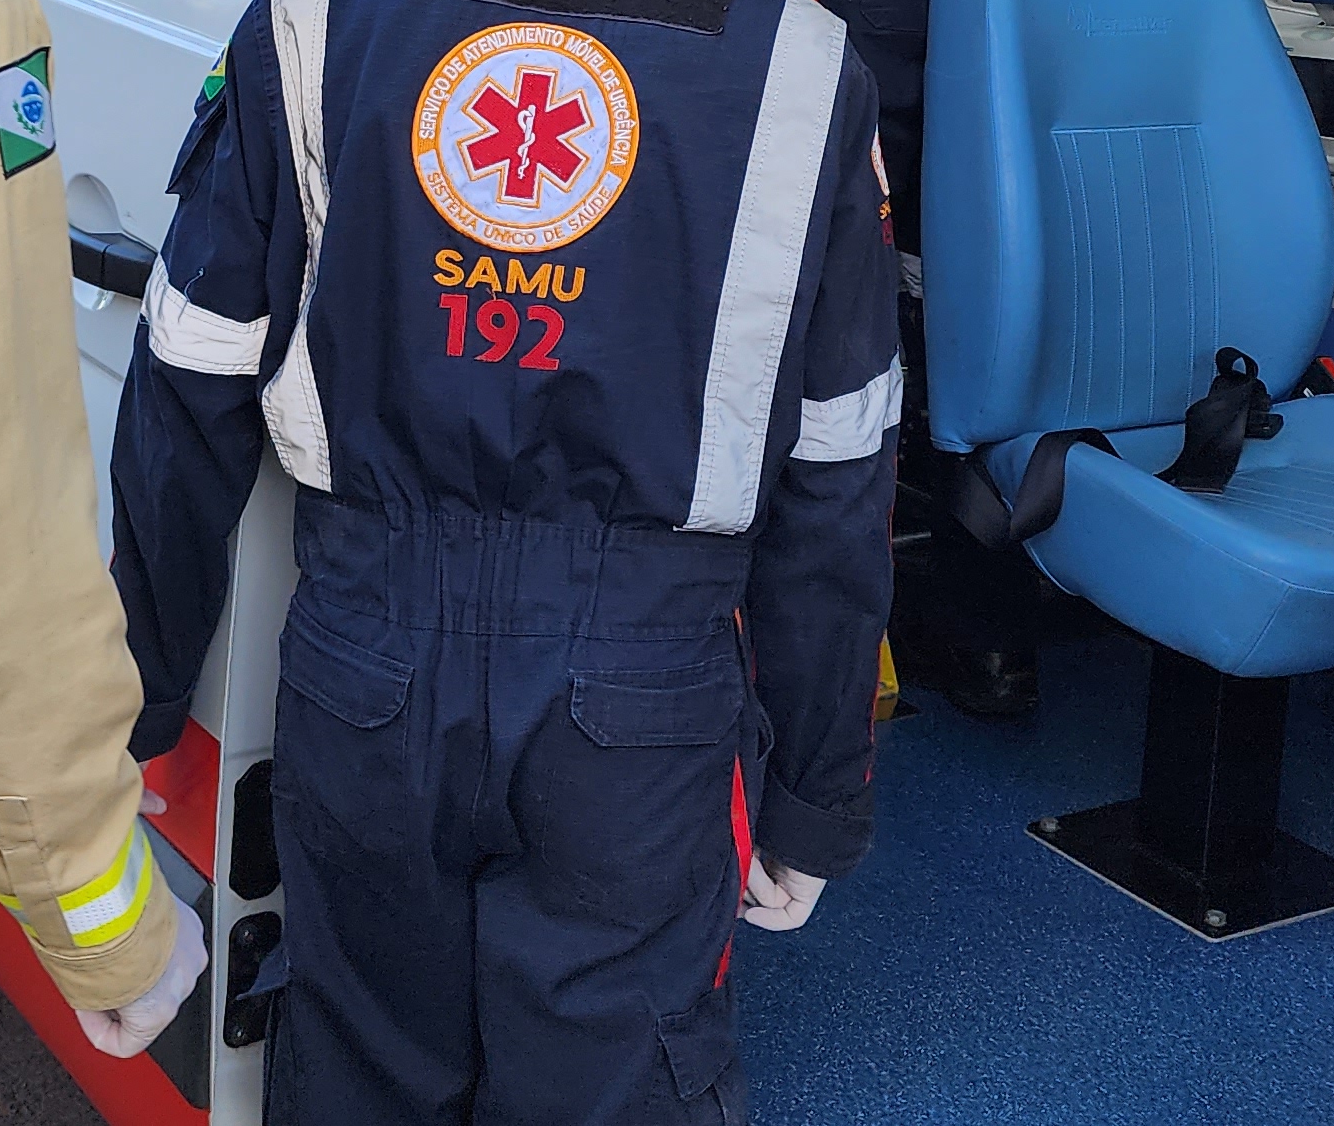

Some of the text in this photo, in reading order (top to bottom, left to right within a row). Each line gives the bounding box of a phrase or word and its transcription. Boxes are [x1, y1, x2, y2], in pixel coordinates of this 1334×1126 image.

[418, 26, 638, 167] SERVIÇO DE ATENDIMENTO MÓVEL DE URGÊNCIA
[427, 171, 614, 247] SISTEMA ÚNICO DE SAÚDE
[432, 248, 587, 303] SAMU
[439, 292, 566, 371] 192
